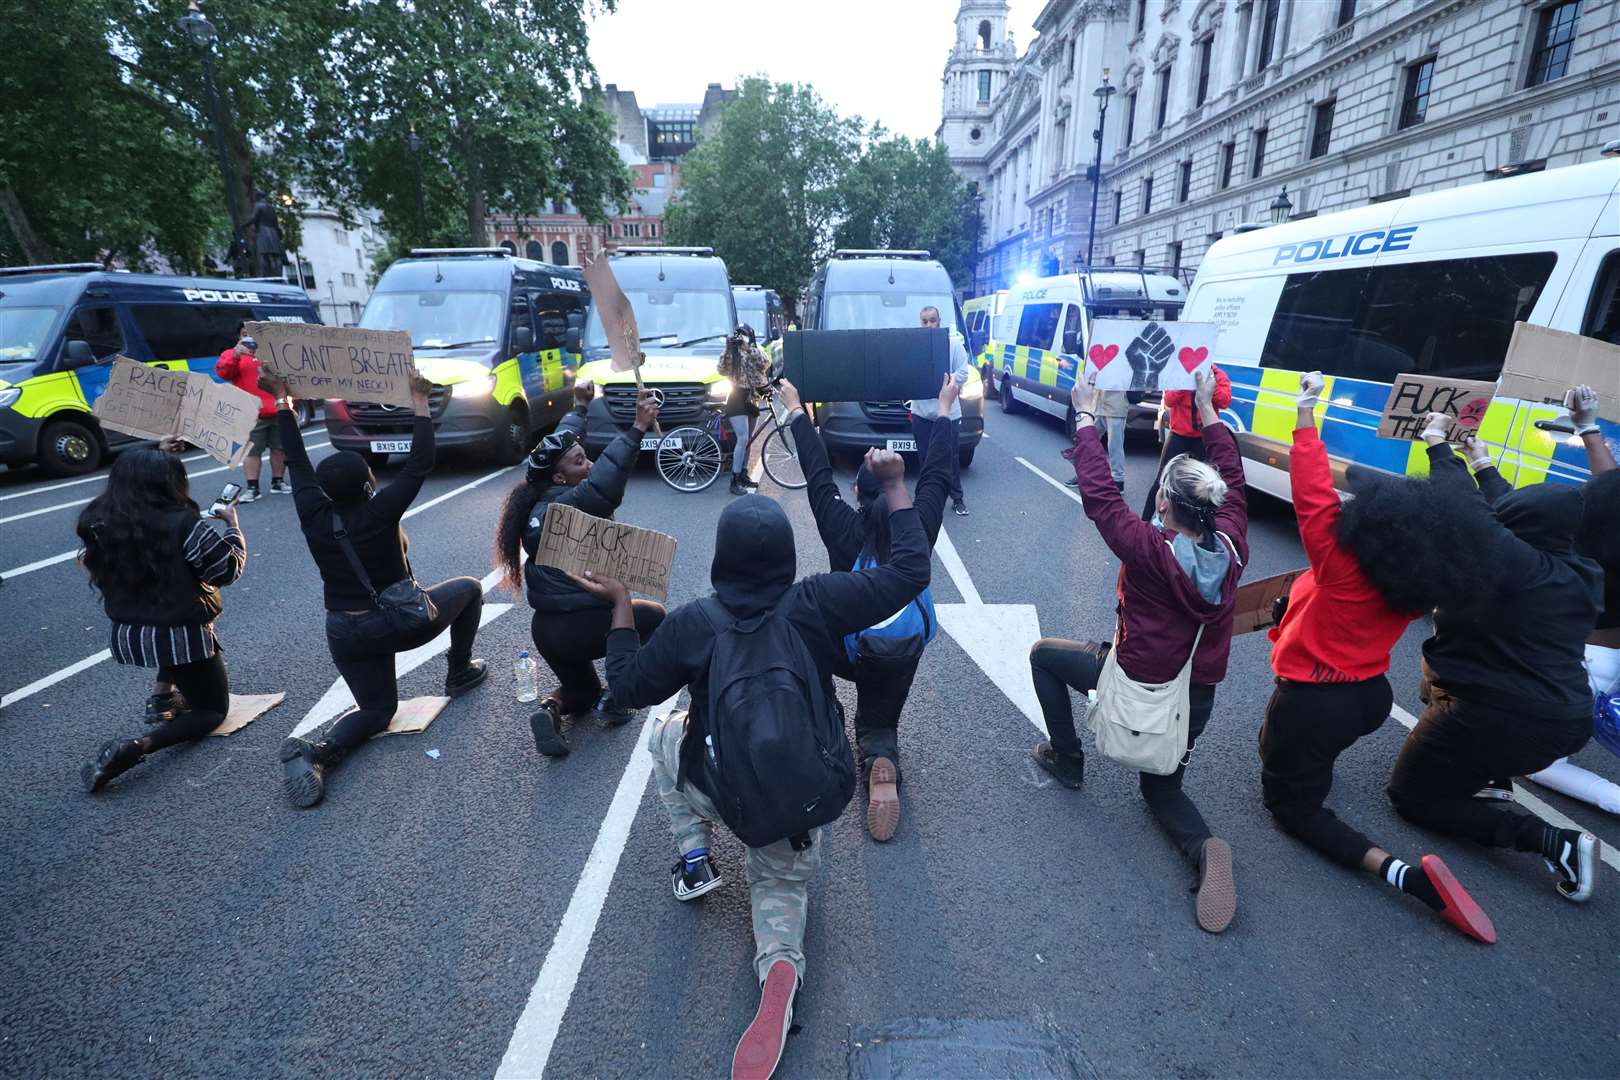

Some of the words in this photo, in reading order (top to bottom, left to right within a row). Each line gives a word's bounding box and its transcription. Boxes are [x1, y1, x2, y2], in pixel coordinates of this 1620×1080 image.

[1272, 226, 1418, 266] POLICE
[182, 289, 261, 303] POLICE
[550, 276, 581, 291] POLICE
[268, 341, 279, 370] I
[129, 366, 203, 399] RACISM
[215, 400, 242, 417] NOT
[311, 376, 331, 386] OFF
[338, 377, 352, 389] MY
[1391, 382, 1471, 417] FUCK
[1389, 415, 1426, 441] THE
[376, 442, 395, 451] BX19
[892, 441, 911, 450] BX19
[548, 508, 632, 553] BLACK
[545, 534, 600, 565] LIVES
